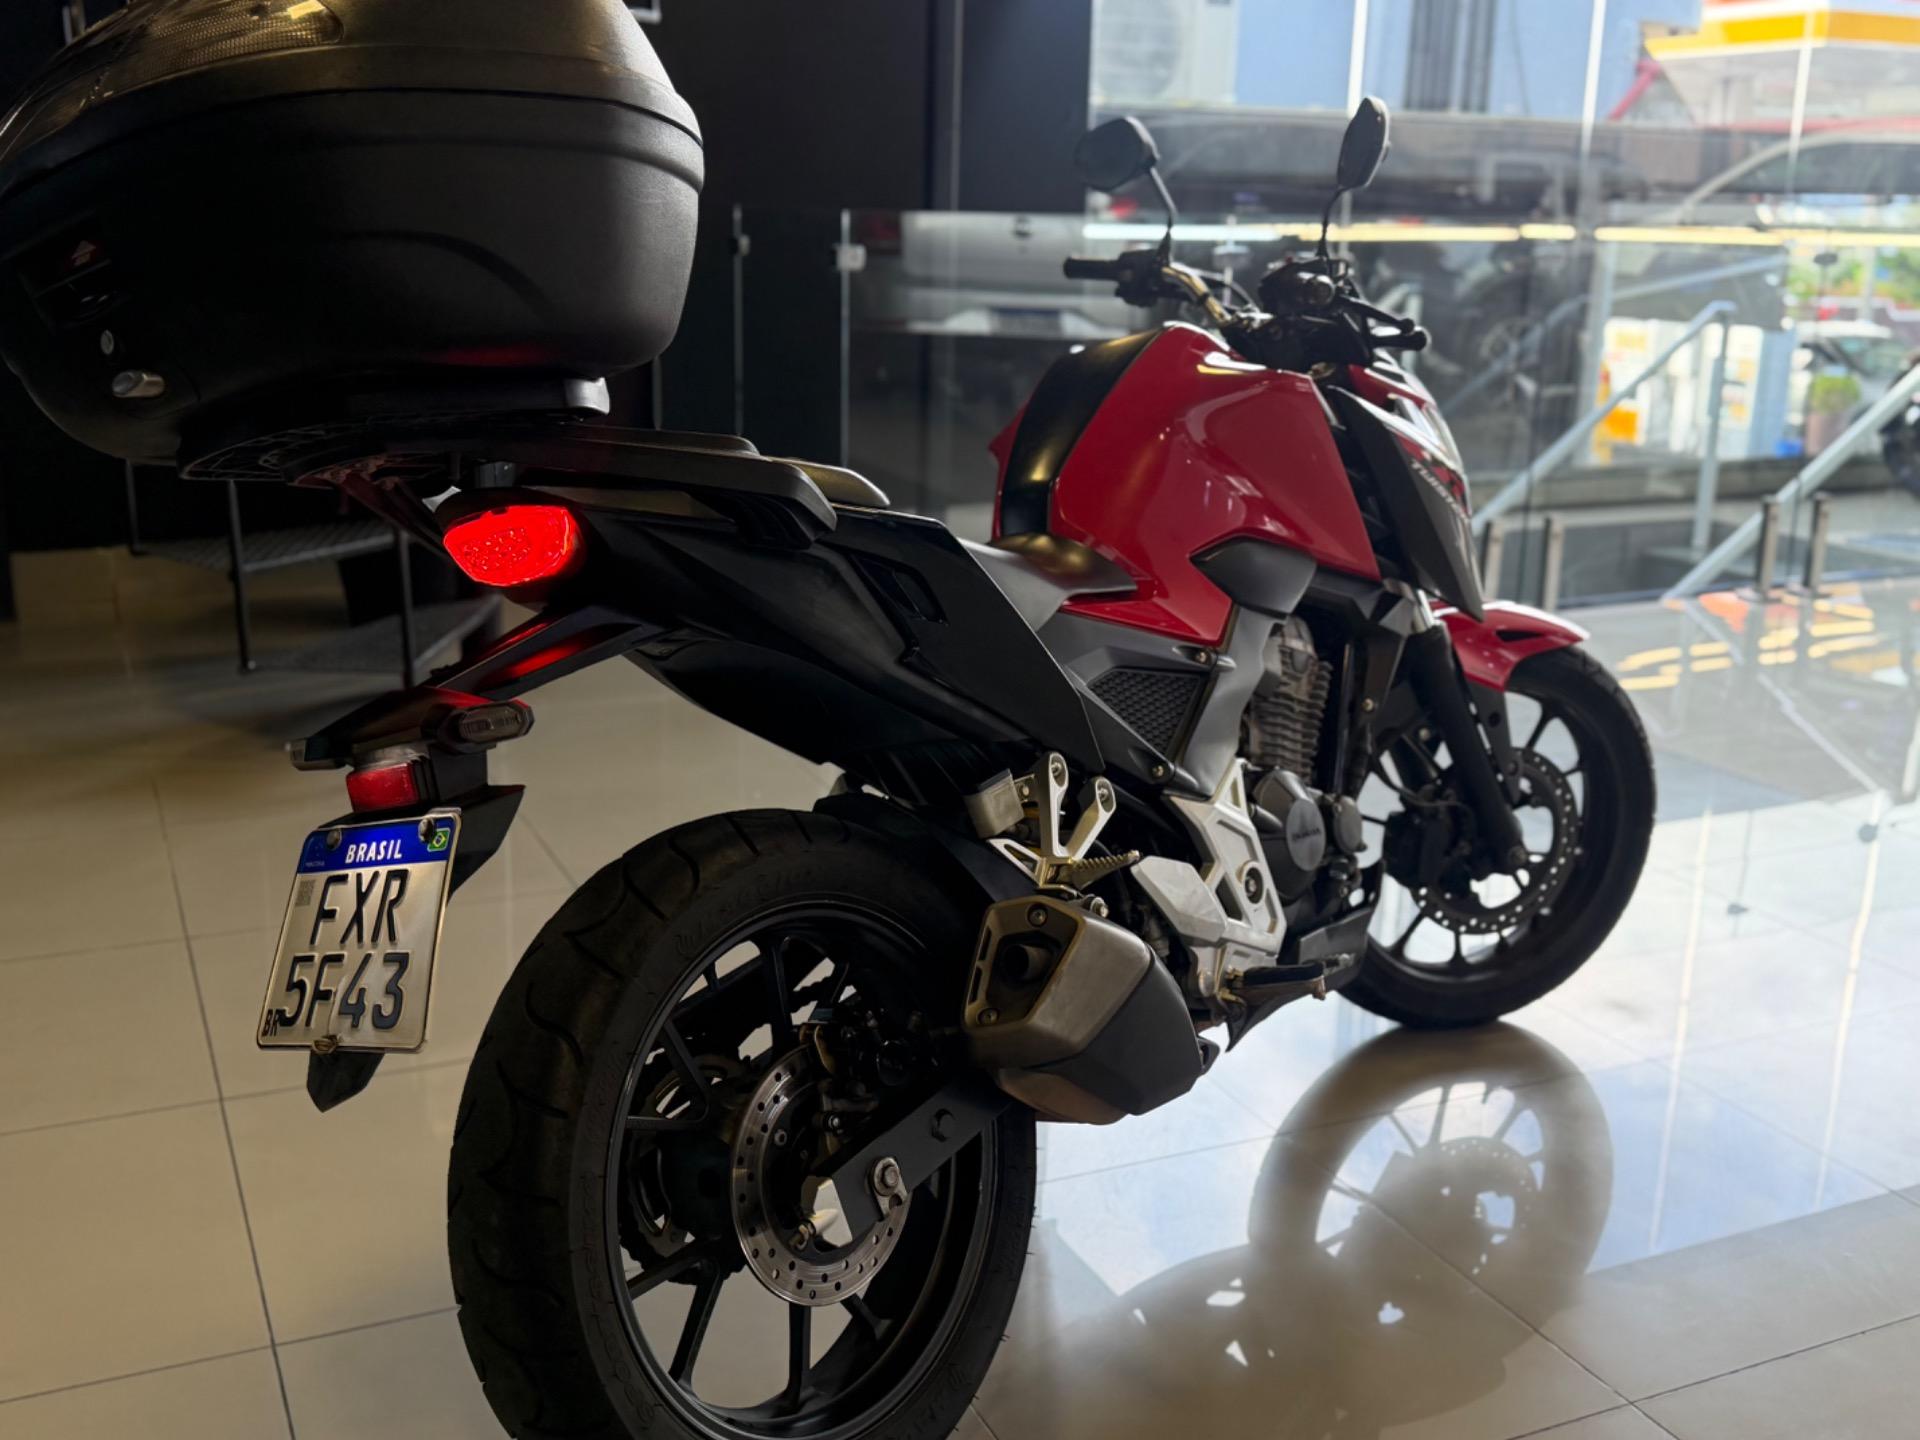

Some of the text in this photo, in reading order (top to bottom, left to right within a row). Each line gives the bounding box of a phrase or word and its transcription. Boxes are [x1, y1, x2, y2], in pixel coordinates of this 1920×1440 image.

[345, 839, 402, 864] BRASIL
[309, 868, 409, 946] FXR
[278, 951, 410, 1030] 5F43
